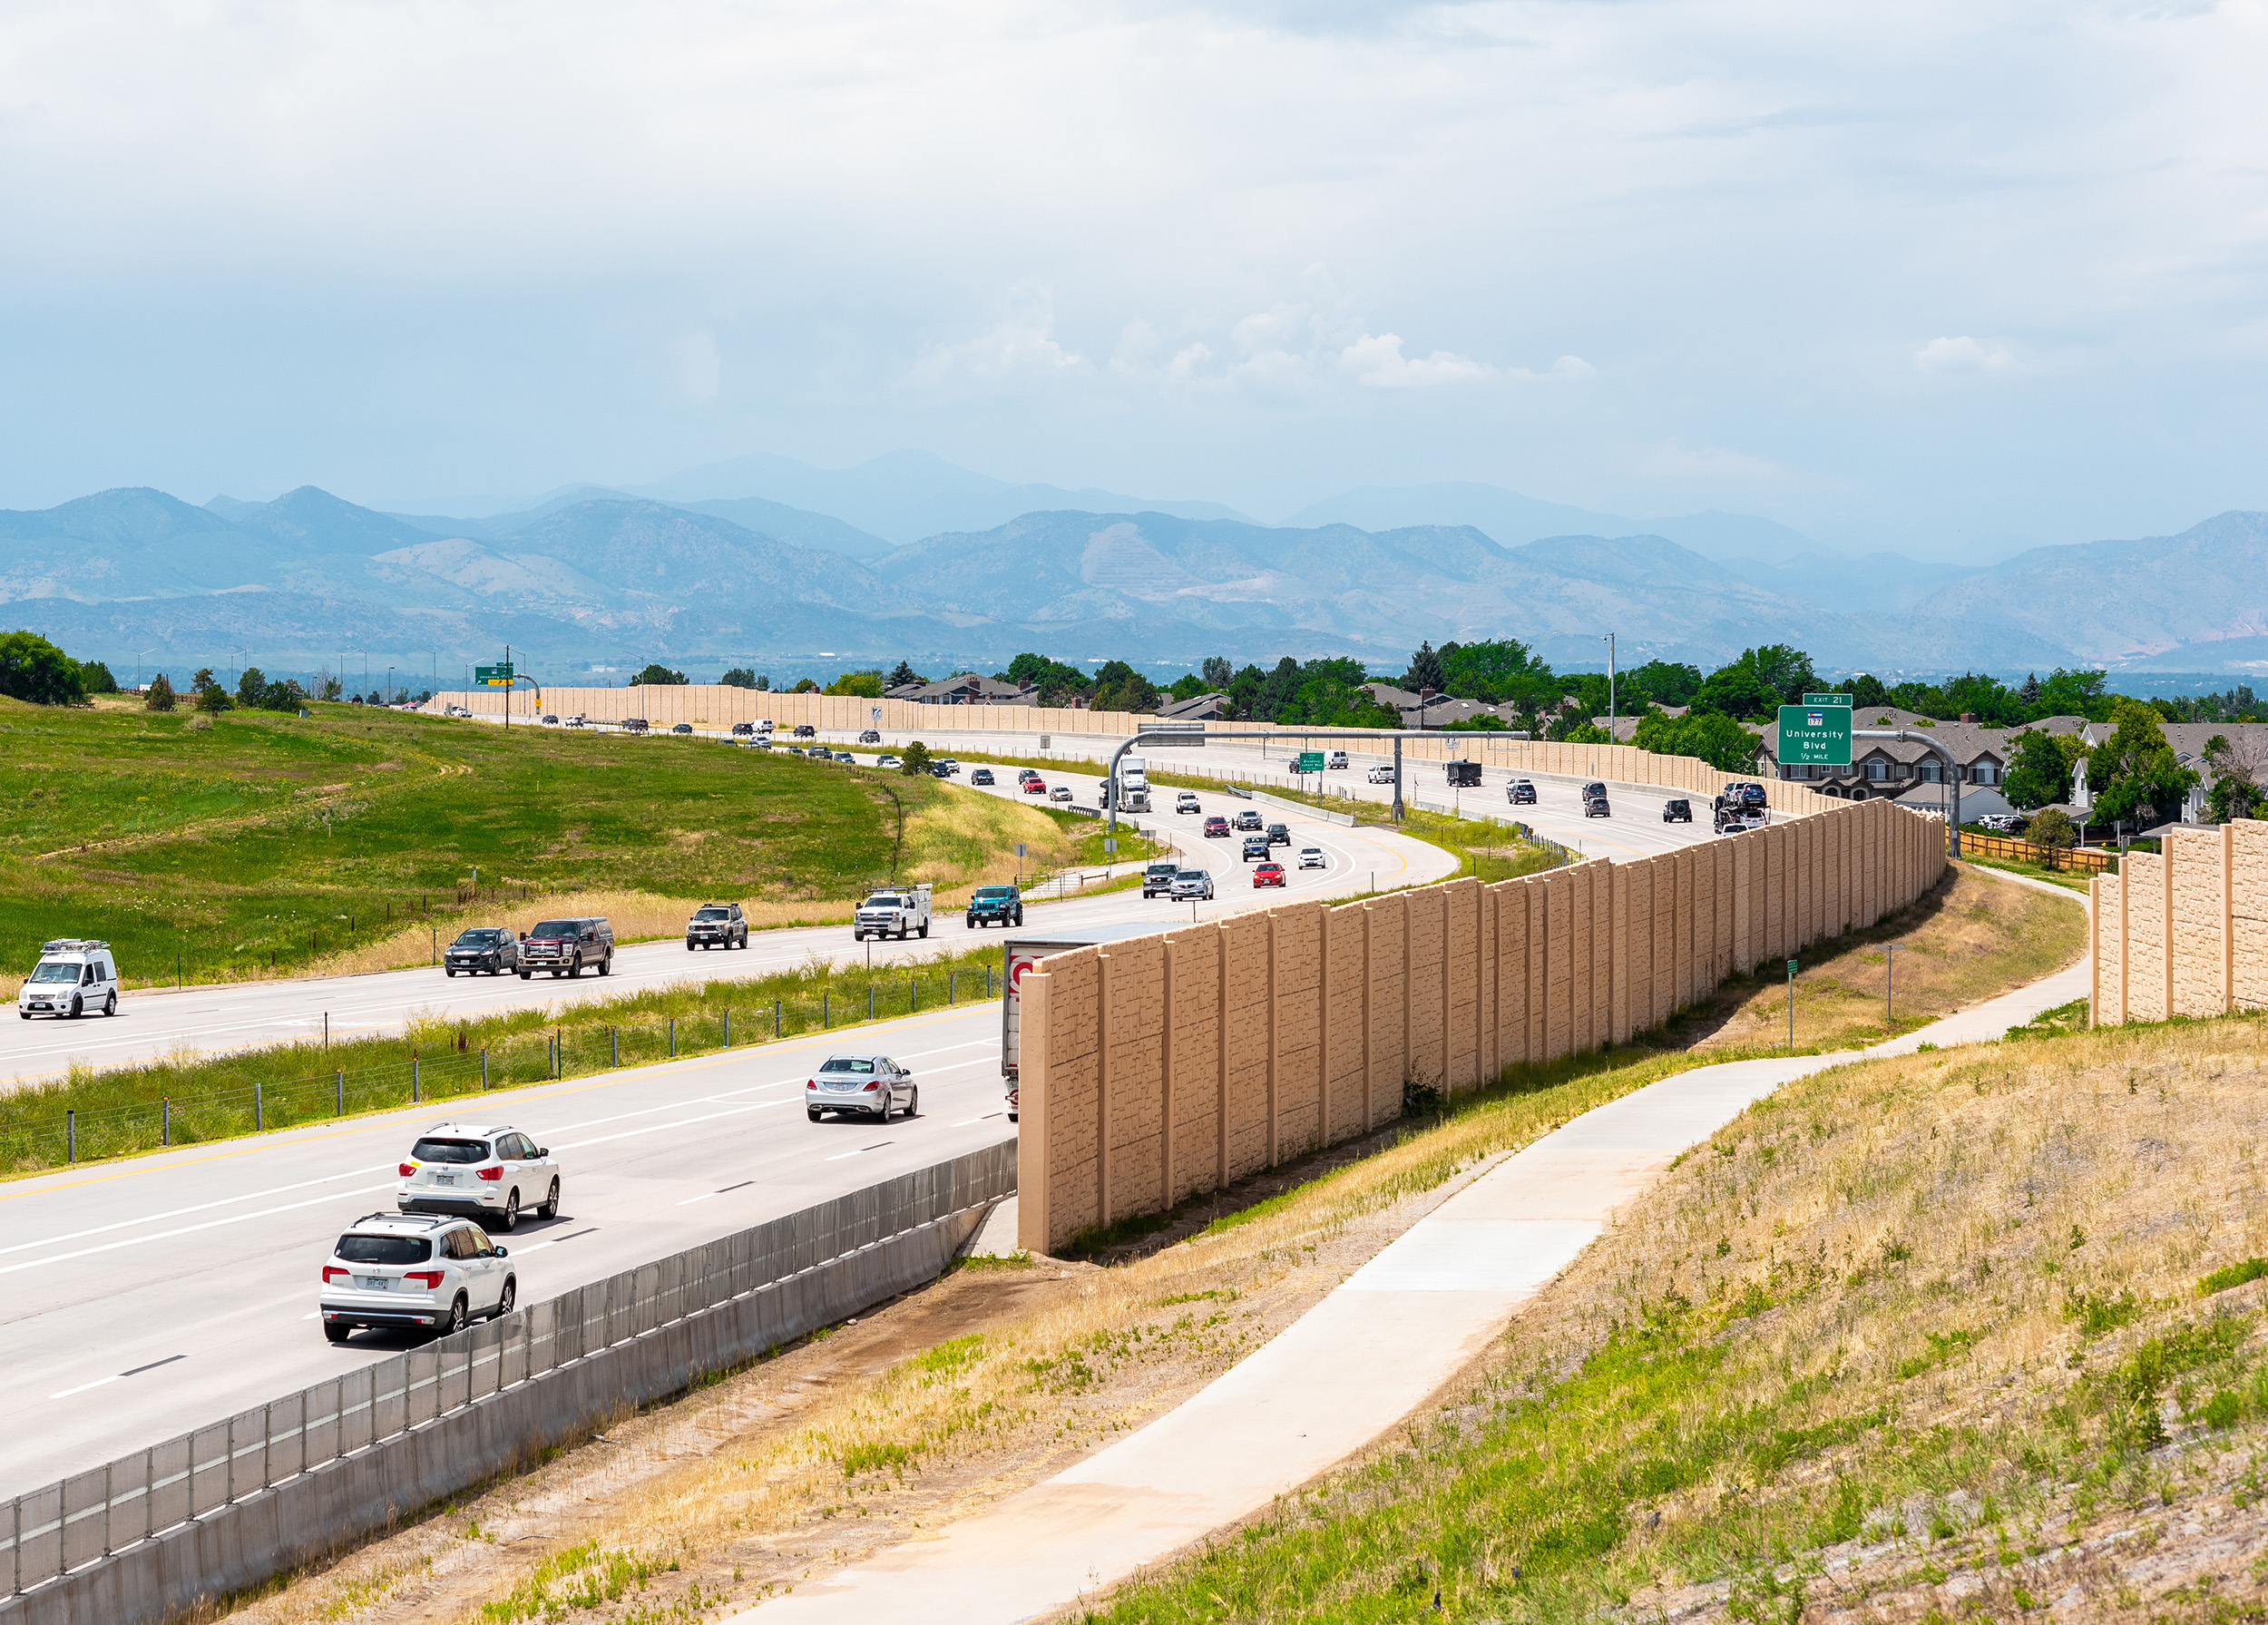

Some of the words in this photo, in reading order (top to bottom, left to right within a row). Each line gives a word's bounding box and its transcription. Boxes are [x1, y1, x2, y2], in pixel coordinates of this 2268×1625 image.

[1833, 696, 1843, 704] 21
[1785, 729, 1843, 739] University
[1803, 741, 1826, 749] Blvd
